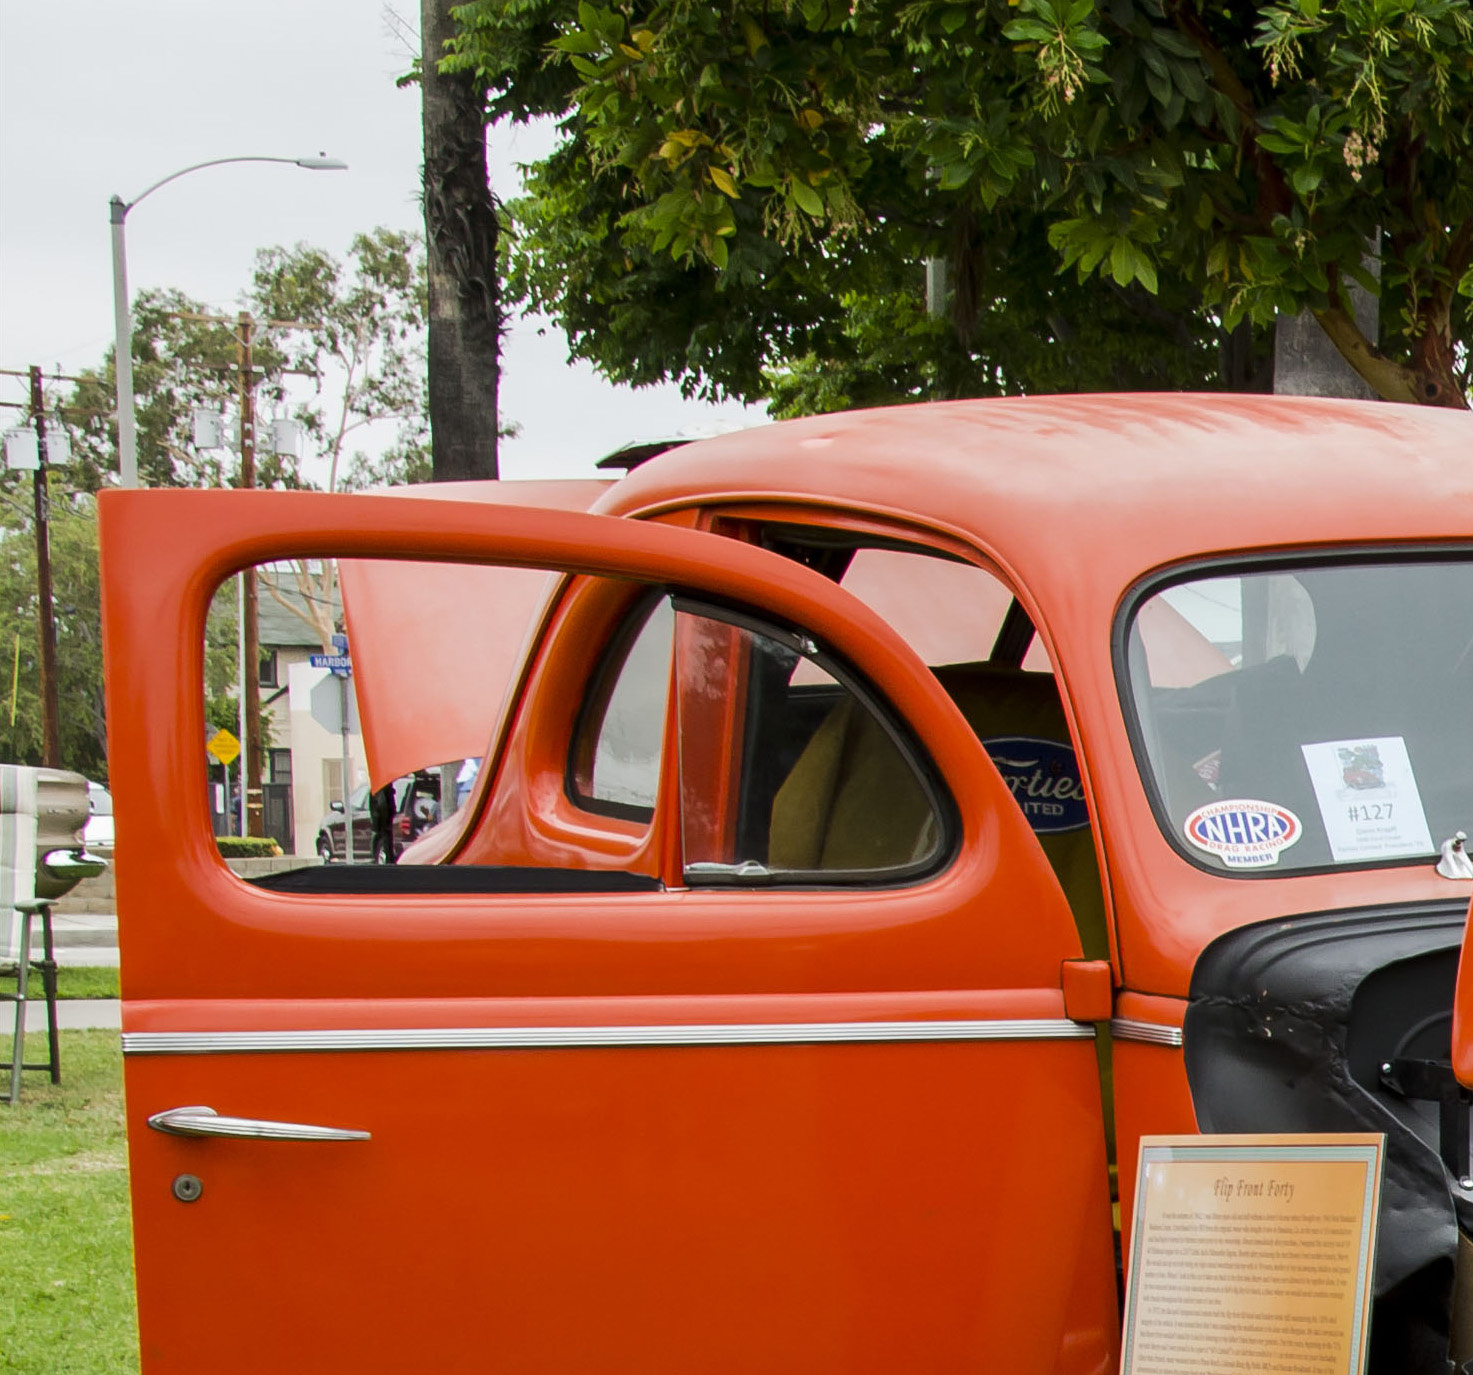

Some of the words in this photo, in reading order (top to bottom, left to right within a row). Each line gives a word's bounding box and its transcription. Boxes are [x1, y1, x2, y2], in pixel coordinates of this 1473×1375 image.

[1201, 803, 1278, 817] CHAMPIONSHIP
[1348, 803, 1393, 821] #127
[1204, 812, 1283, 844] NHRA
[1208, 841, 1239, 853] DRAG
[1244, 838, 1285, 853] RACING
[1227, 853, 1274, 864] MEMBER
[1214, 1176, 1234, 1202] Flip
[1237, 1178, 1264, 1197] Front
[1268, 1179, 1295, 1203] Forty
